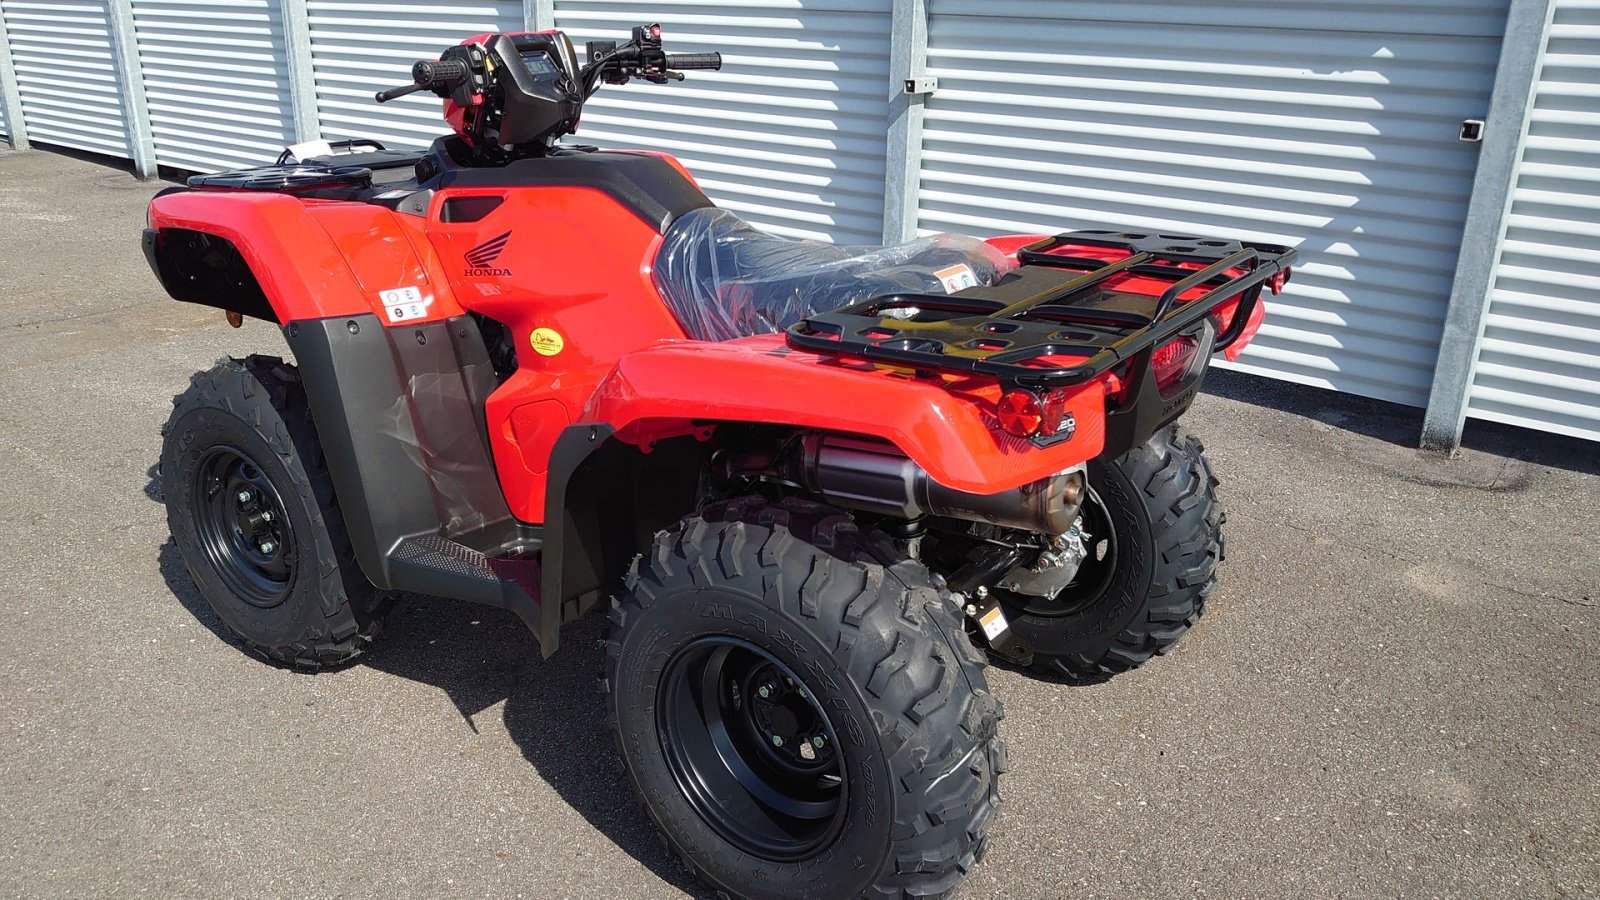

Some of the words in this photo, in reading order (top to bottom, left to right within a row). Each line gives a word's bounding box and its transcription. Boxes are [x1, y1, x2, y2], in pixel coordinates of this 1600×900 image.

[464, 268, 512, 277] HONDA
[1056, 418, 1076, 431] 20
[701, 601, 868, 748] MAXXIS
